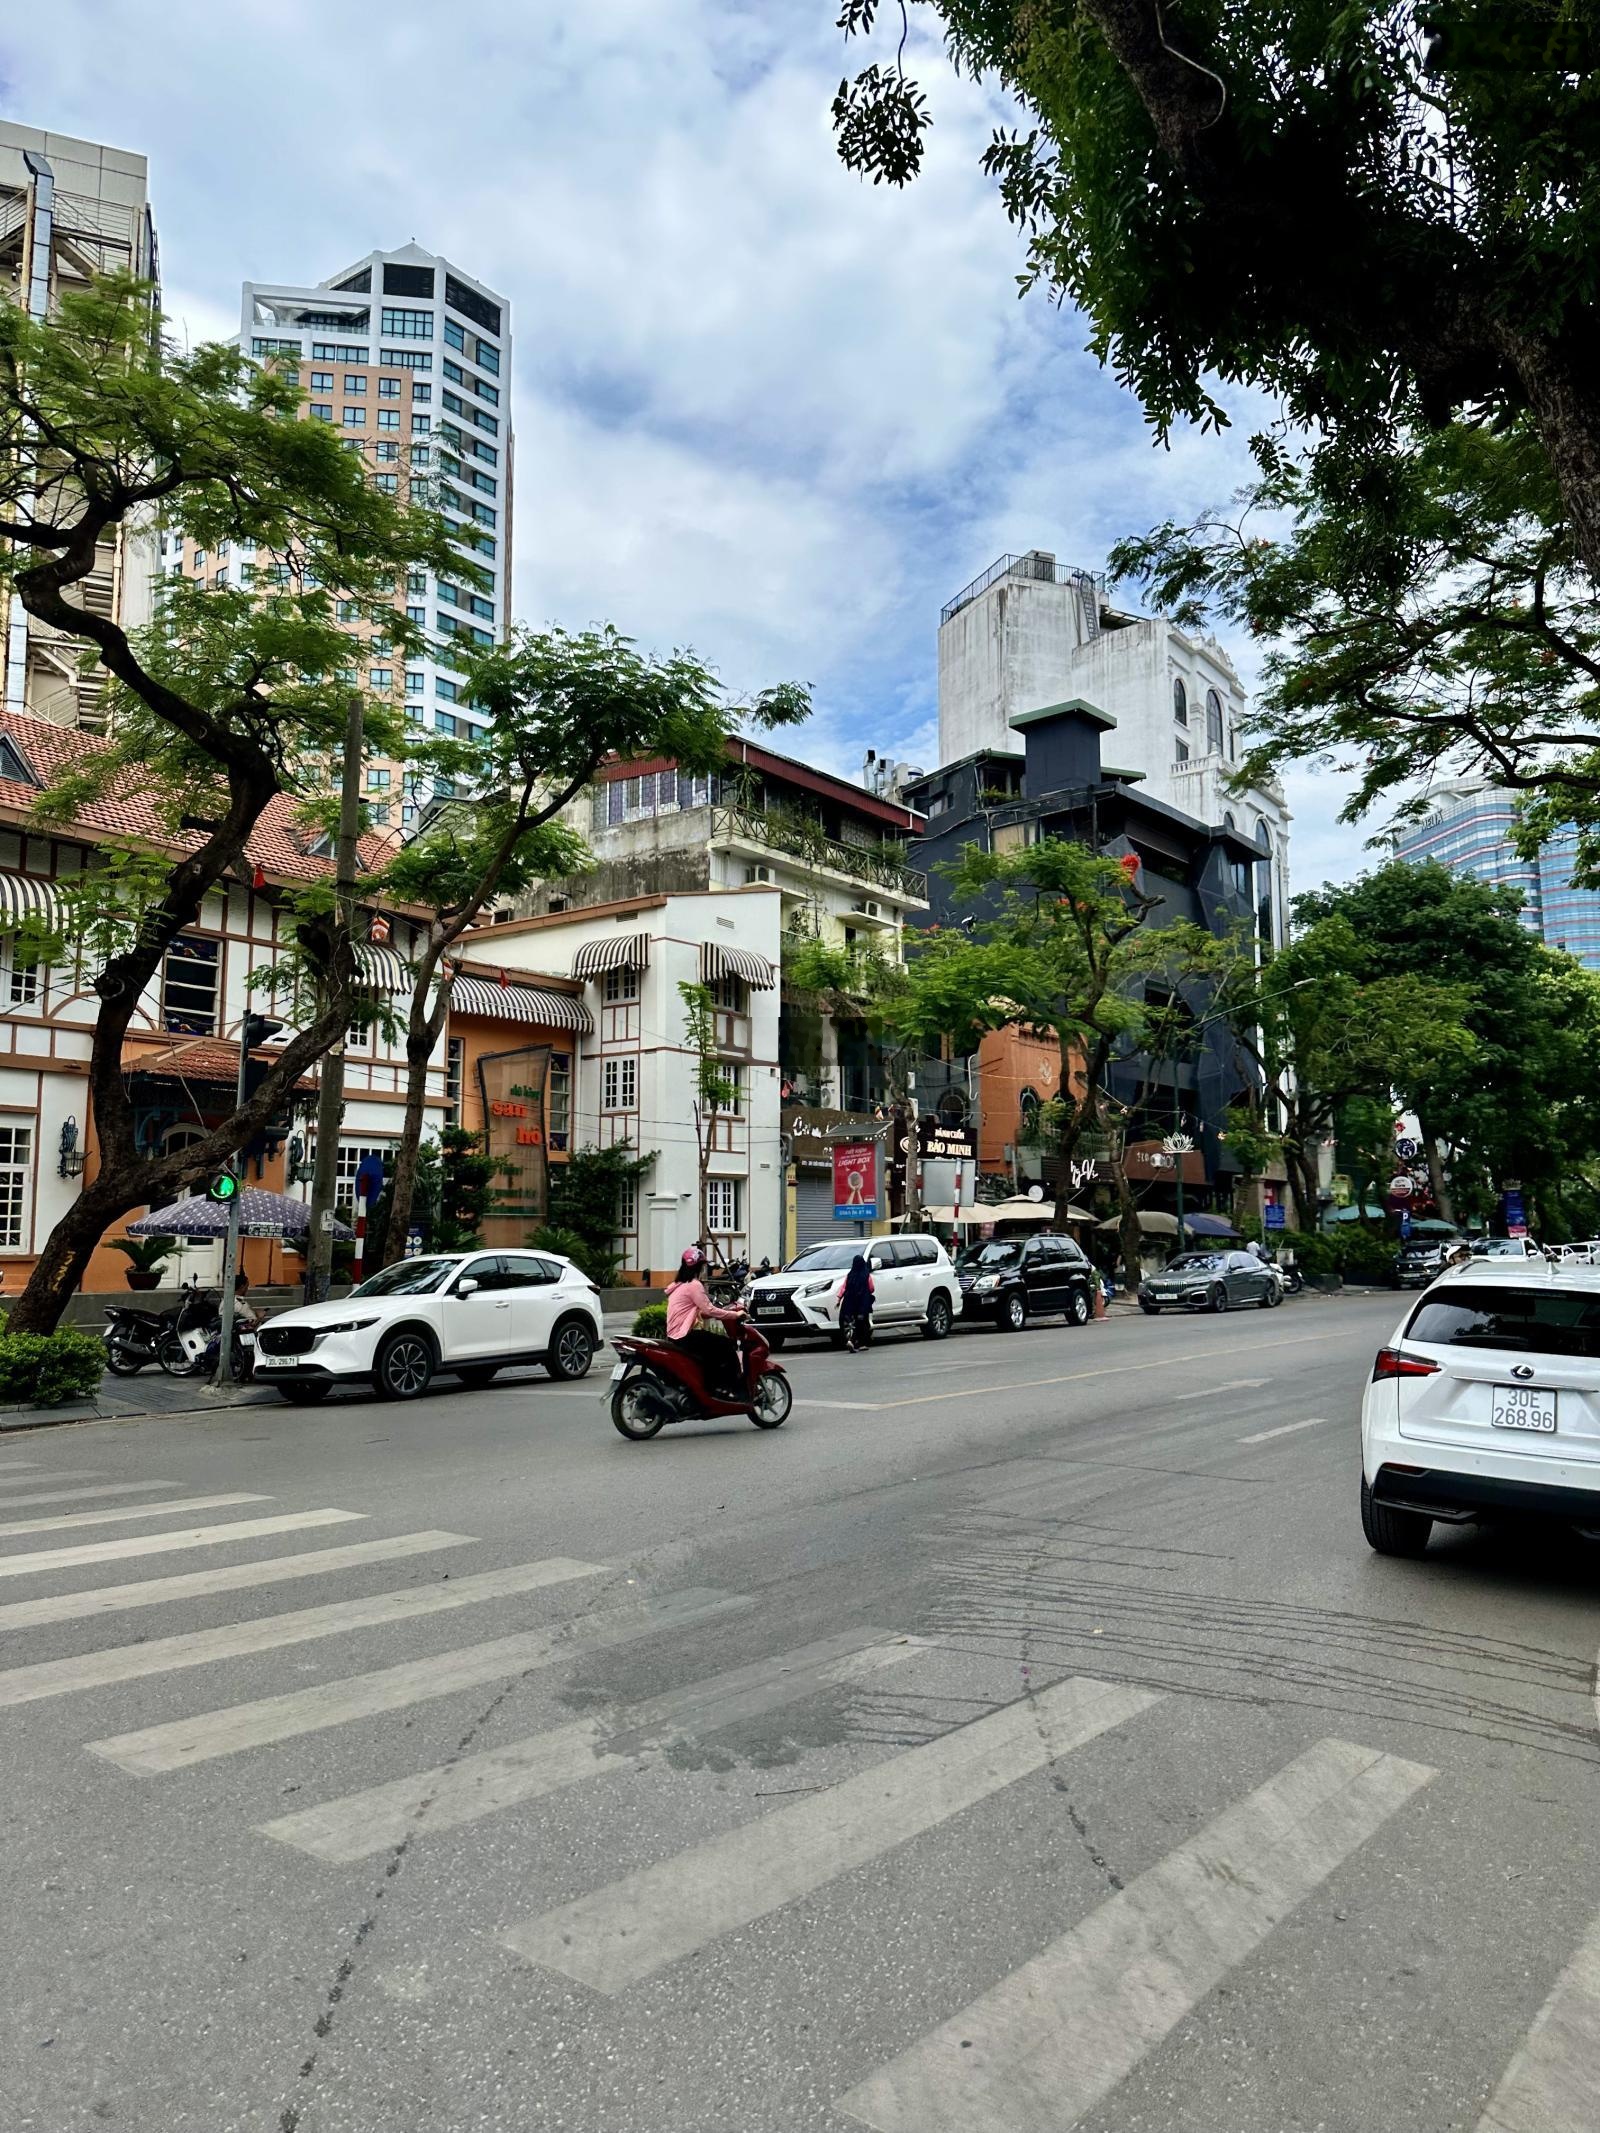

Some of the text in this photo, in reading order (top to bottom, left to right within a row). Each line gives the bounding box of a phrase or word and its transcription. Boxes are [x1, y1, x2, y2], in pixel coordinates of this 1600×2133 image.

[926, 1139, 972, 1156] BẢO MINH
[1507, 1389, 1541, 1409] 30E
[1494, 1407, 1553, 1429] 268.96
